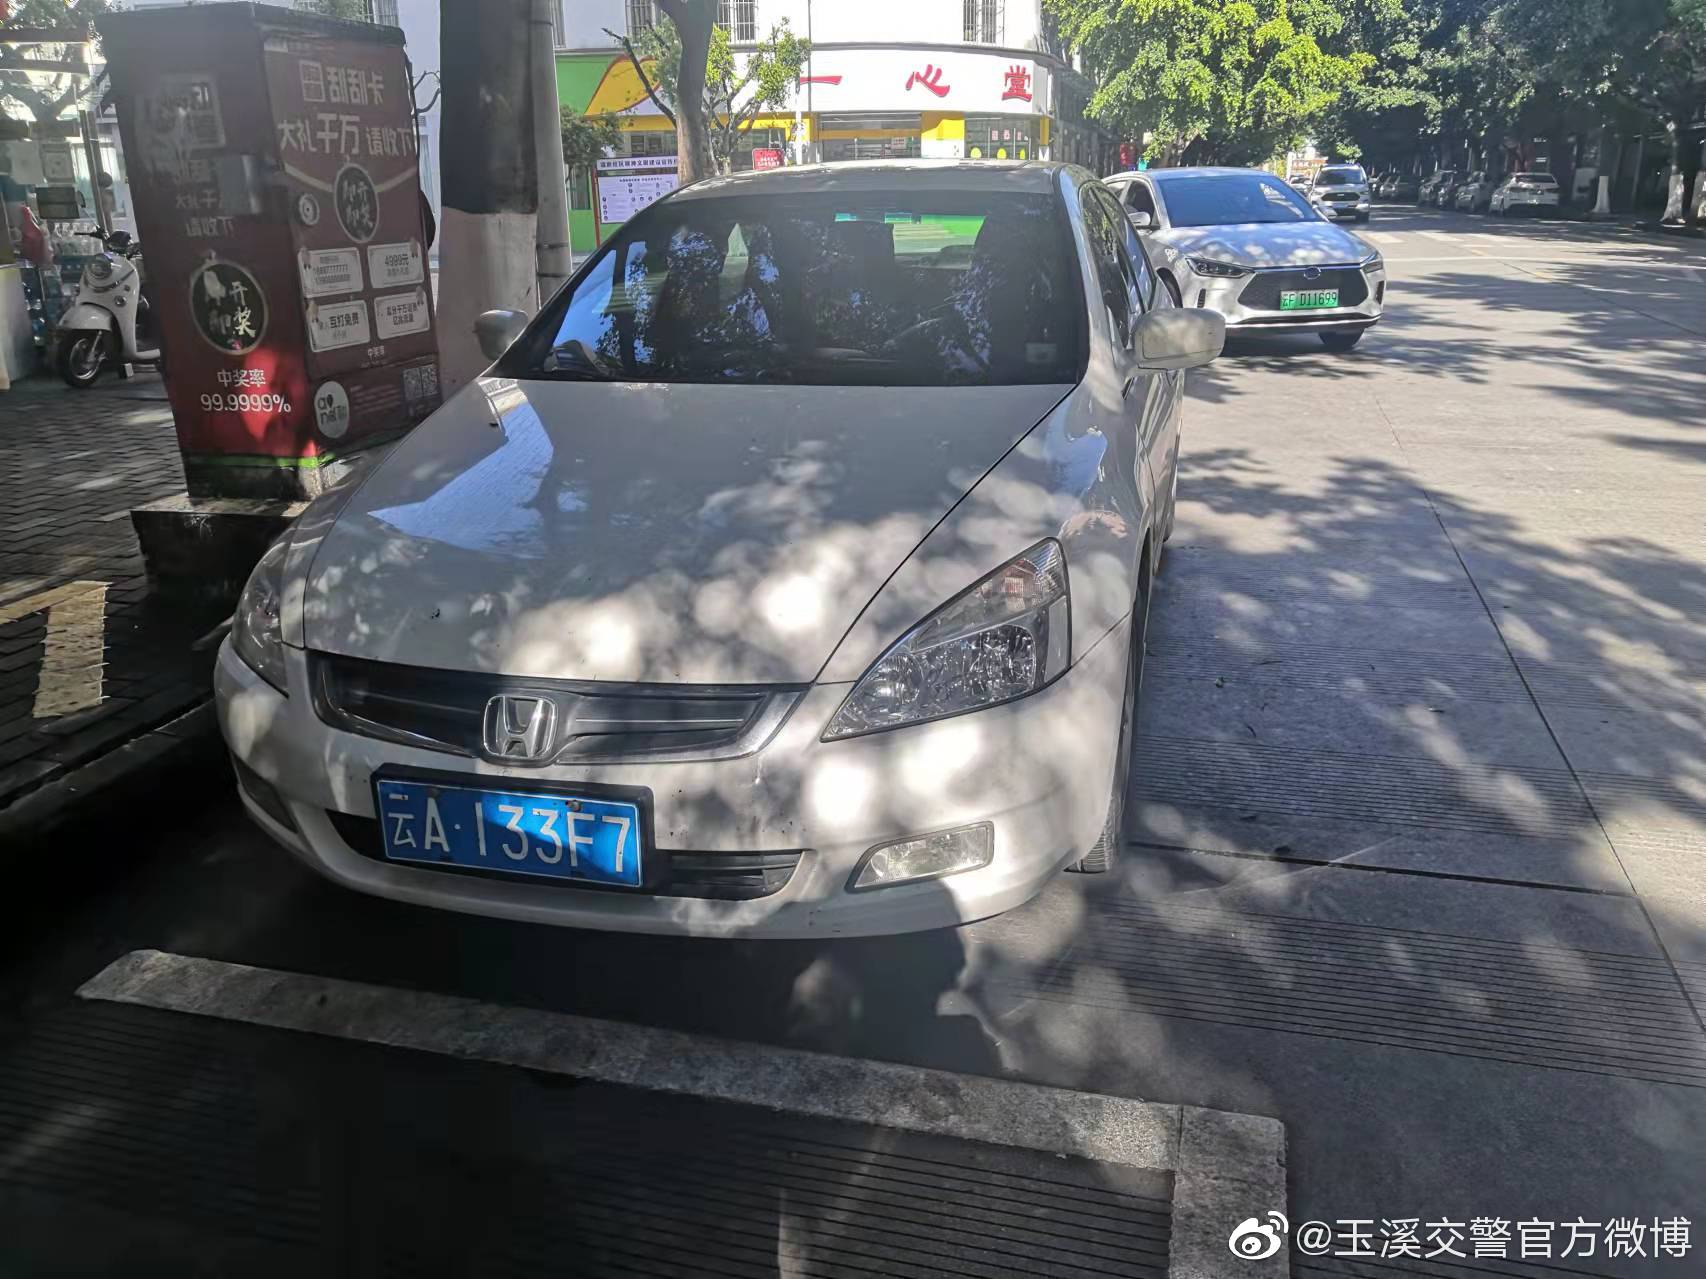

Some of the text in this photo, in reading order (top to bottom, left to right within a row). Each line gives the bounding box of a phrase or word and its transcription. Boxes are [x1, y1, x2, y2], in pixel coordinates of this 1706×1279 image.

[326, 66, 385, 105] 刮刮卡
[798, 64, 1034, 102] 一心堂
[217, 369, 266, 387] 中奖率
[201, 394, 292, 413] 99.9999%
